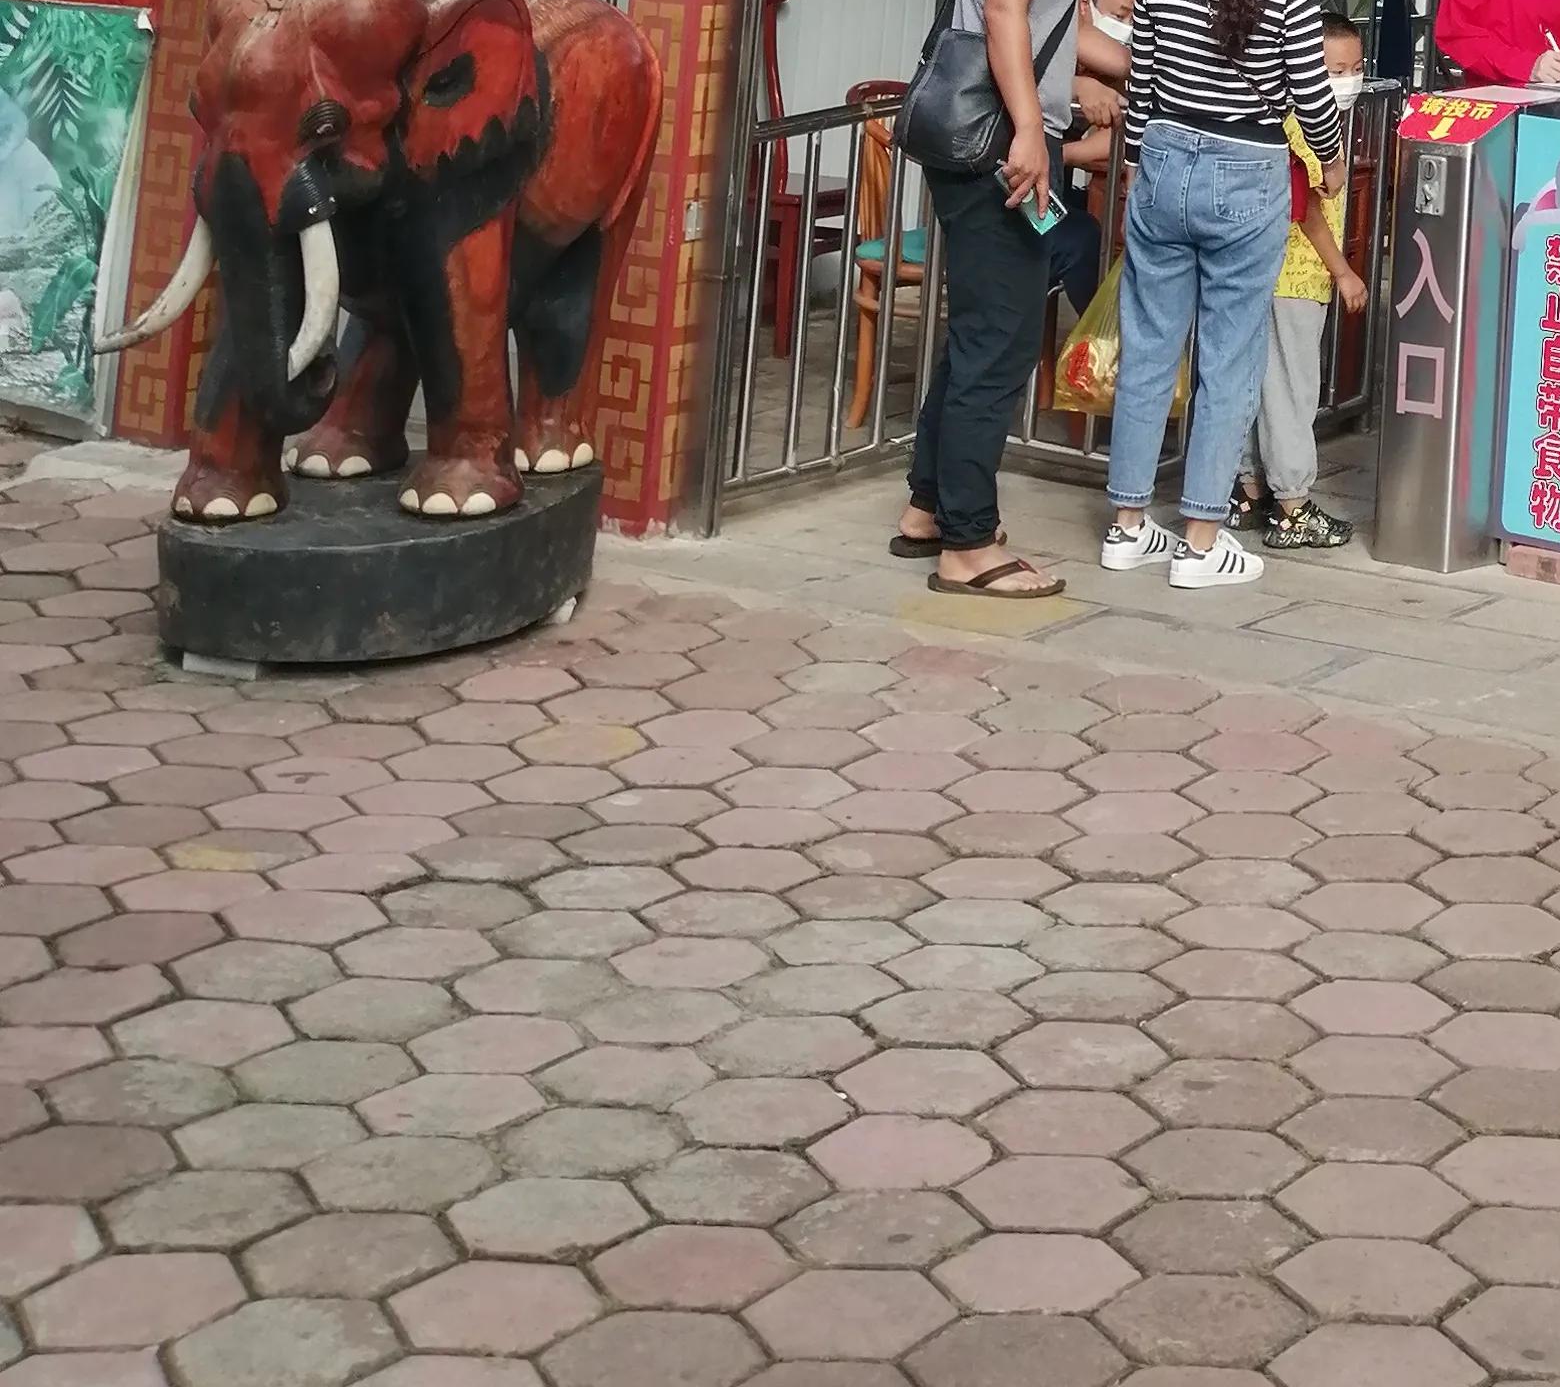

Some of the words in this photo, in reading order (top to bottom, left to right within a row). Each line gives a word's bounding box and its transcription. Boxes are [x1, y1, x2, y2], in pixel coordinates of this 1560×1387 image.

[1418, 97, 1497, 120] 请投币
[1396, 227, 1454, 420] 入口
